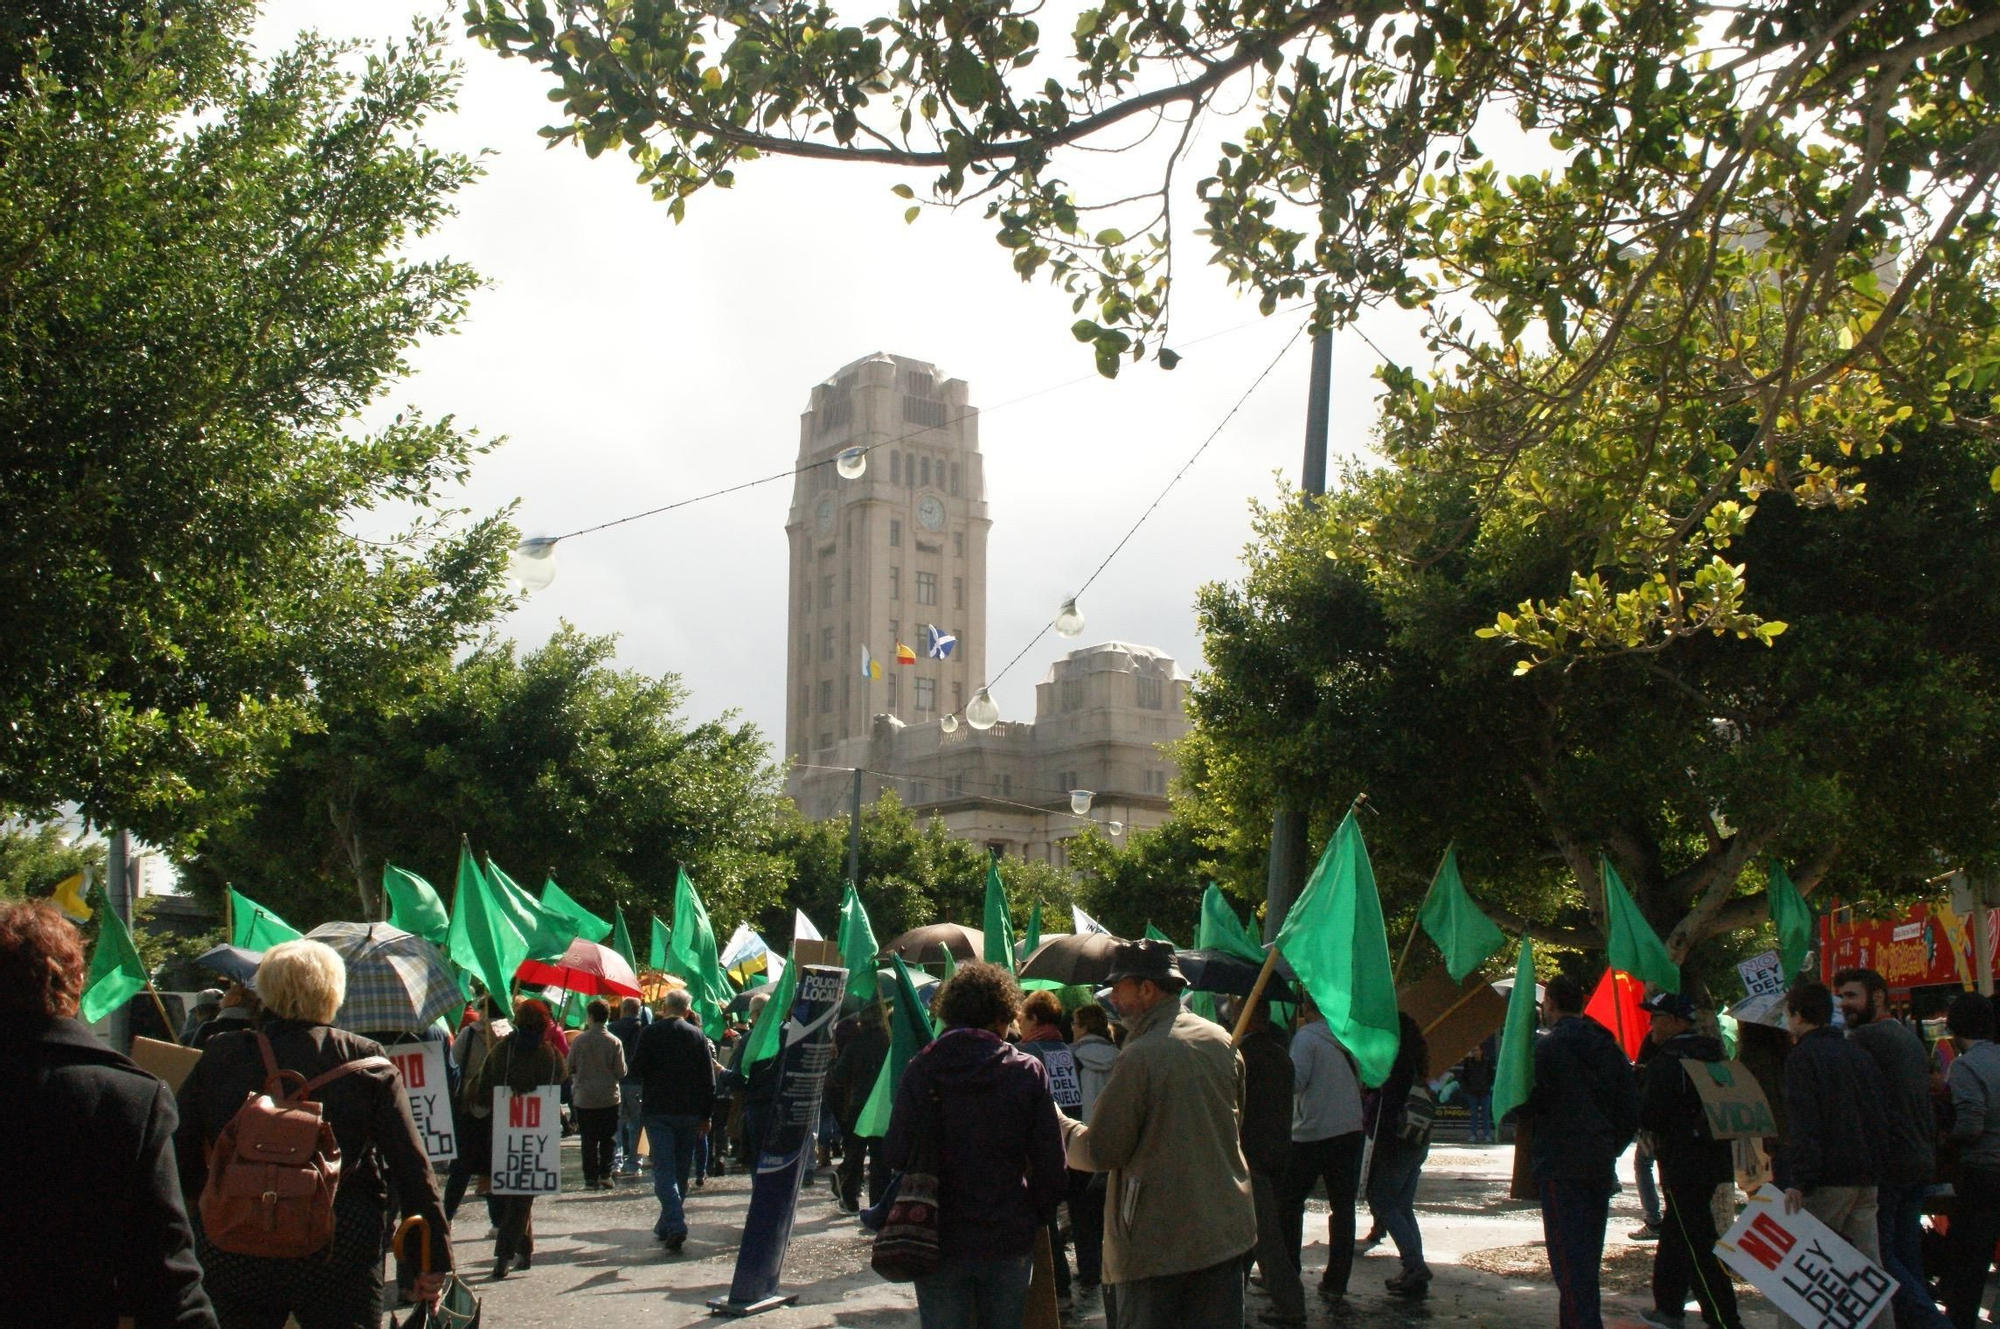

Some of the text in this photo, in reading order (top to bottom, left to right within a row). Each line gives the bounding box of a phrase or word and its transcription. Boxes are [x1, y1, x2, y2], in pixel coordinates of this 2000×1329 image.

[1740, 953, 1777, 976] NO
[1745, 963, 1779, 985] LEY
[1752, 976, 1783, 993] DEL
[801, 988, 838, 1002] LOCAL
[1045, 1052, 1072, 1067] NO
[1048, 1066, 1074, 1078] LEY
[1053, 1078, 1076, 1090] DEL
[409, 1094, 437, 1117] EY
[1053, 1090, 1081, 1105] SUELO
[509, 1096, 541, 1128] NO
[1704, 1101, 1776, 1132] VIDA
[507, 1134, 548, 1154] LEY
[506, 1154, 548, 1173] DEL
[493, 1171, 557, 1191] SUELO
[1737, 1211, 1798, 1271] NO
[1782, 1238, 1834, 1297] LEY
[1805, 1266, 1860, 1316] DEL
